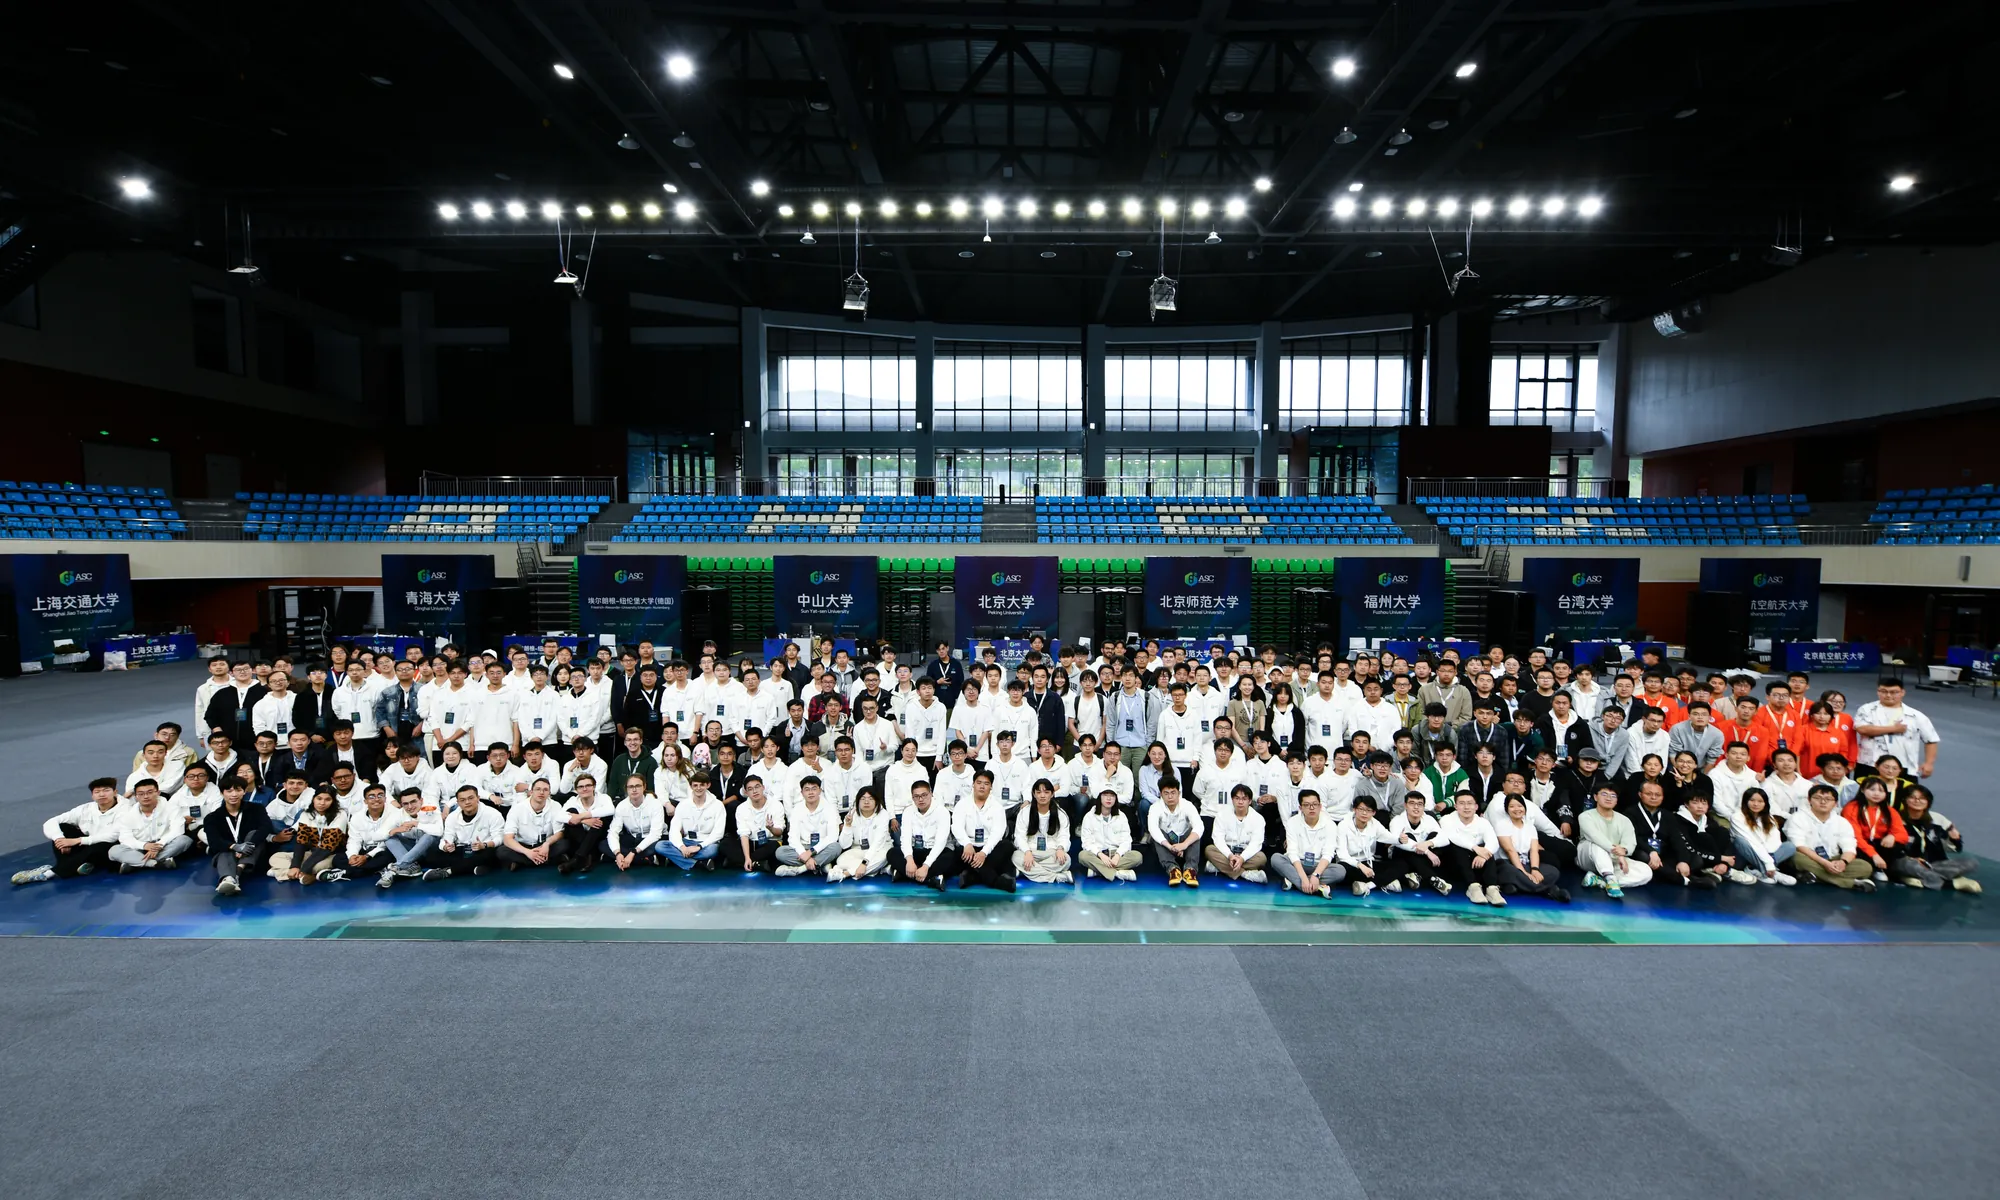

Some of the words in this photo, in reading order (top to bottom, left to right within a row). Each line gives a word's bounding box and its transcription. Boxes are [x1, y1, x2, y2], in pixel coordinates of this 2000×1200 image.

[32, 593, 119, 611] 上海交通大学
[406, 591, 460, 605] 青海大学
[798, 593, 853, 608] 中山大学
[978, 595, 1035, 609] 北京大学
[1160, 595, 1239, 608] 北京师范大学
[1364, 595, 1421, 608] 福州大学
[1558, 595, 1614, 609] 台湾大学
[131, 644, 176, 655] 上海交通大学
[1804, 652, 1864, 660] 北京航空航天大学
